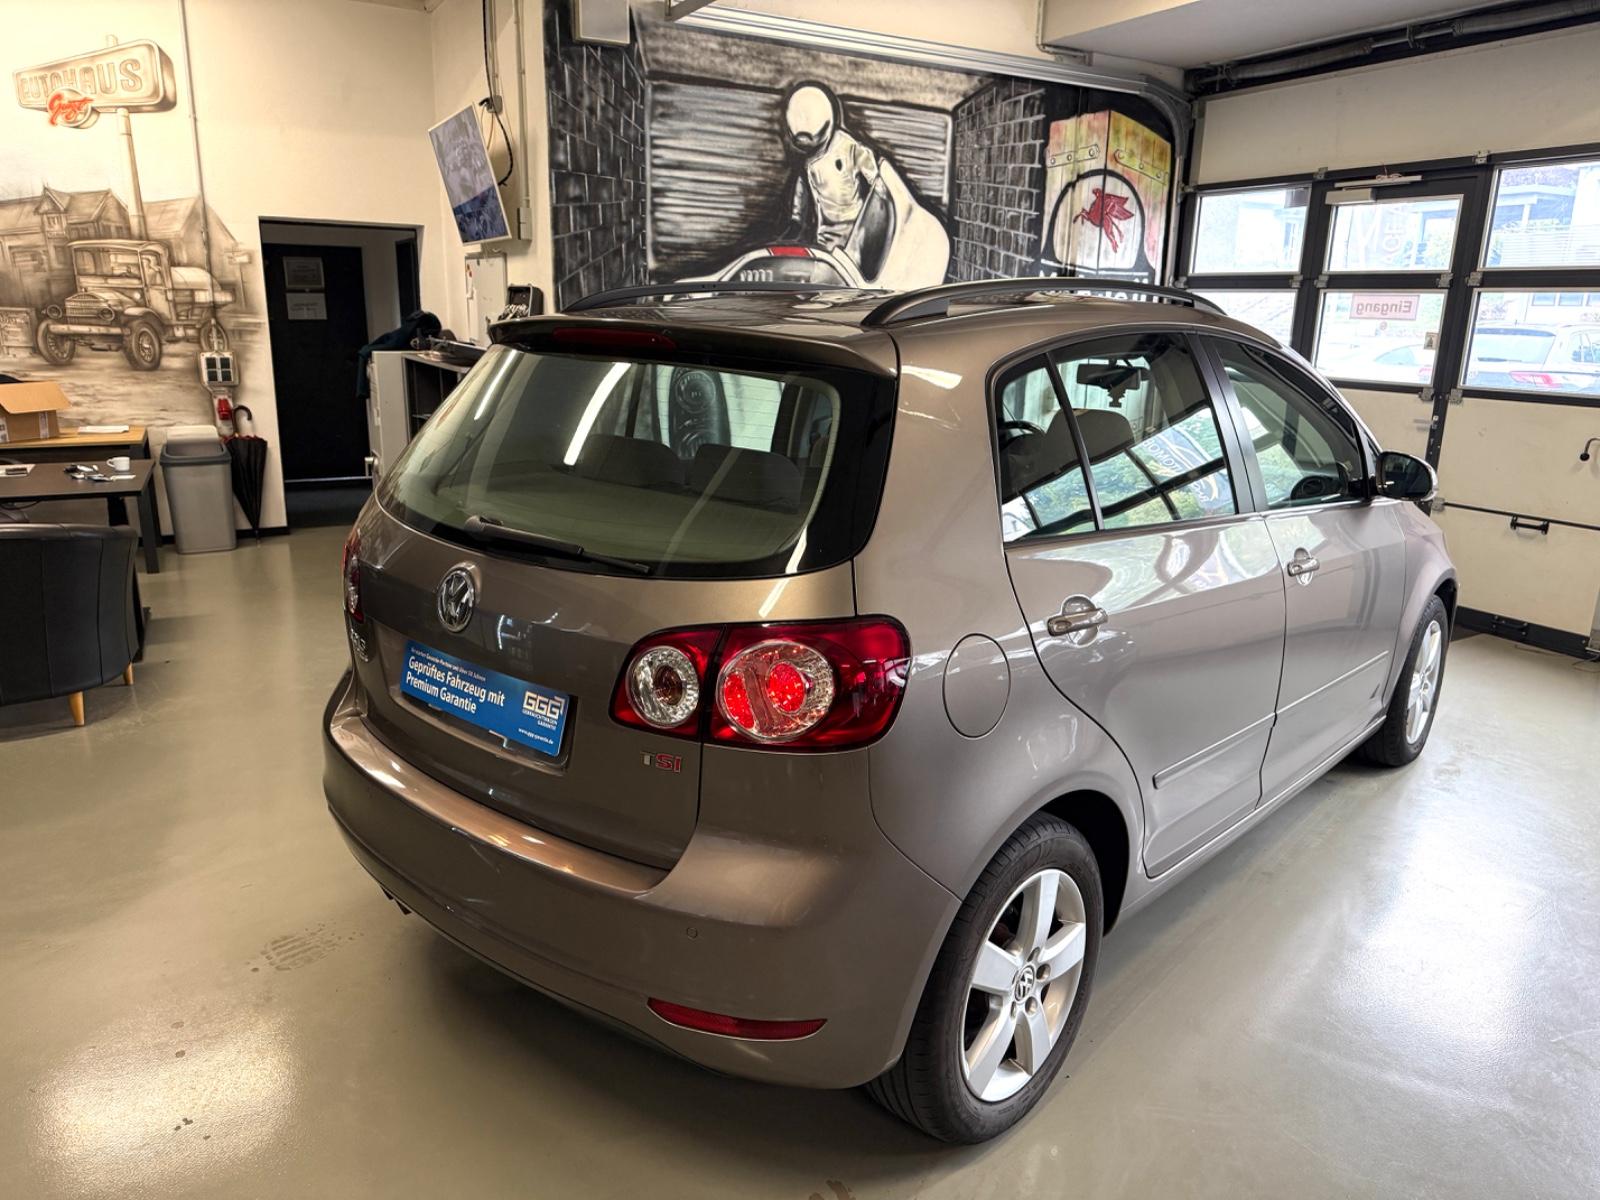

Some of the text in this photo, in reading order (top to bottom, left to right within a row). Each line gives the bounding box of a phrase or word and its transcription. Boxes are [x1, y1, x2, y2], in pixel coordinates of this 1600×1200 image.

[406, 671, 477, 714] Premium Garantie
[408, 656, 506, 707] Geprüftes Fahrzeug mit
[522, 690, 562, 720] GGG
[640, 751, 682, 773] TSI
